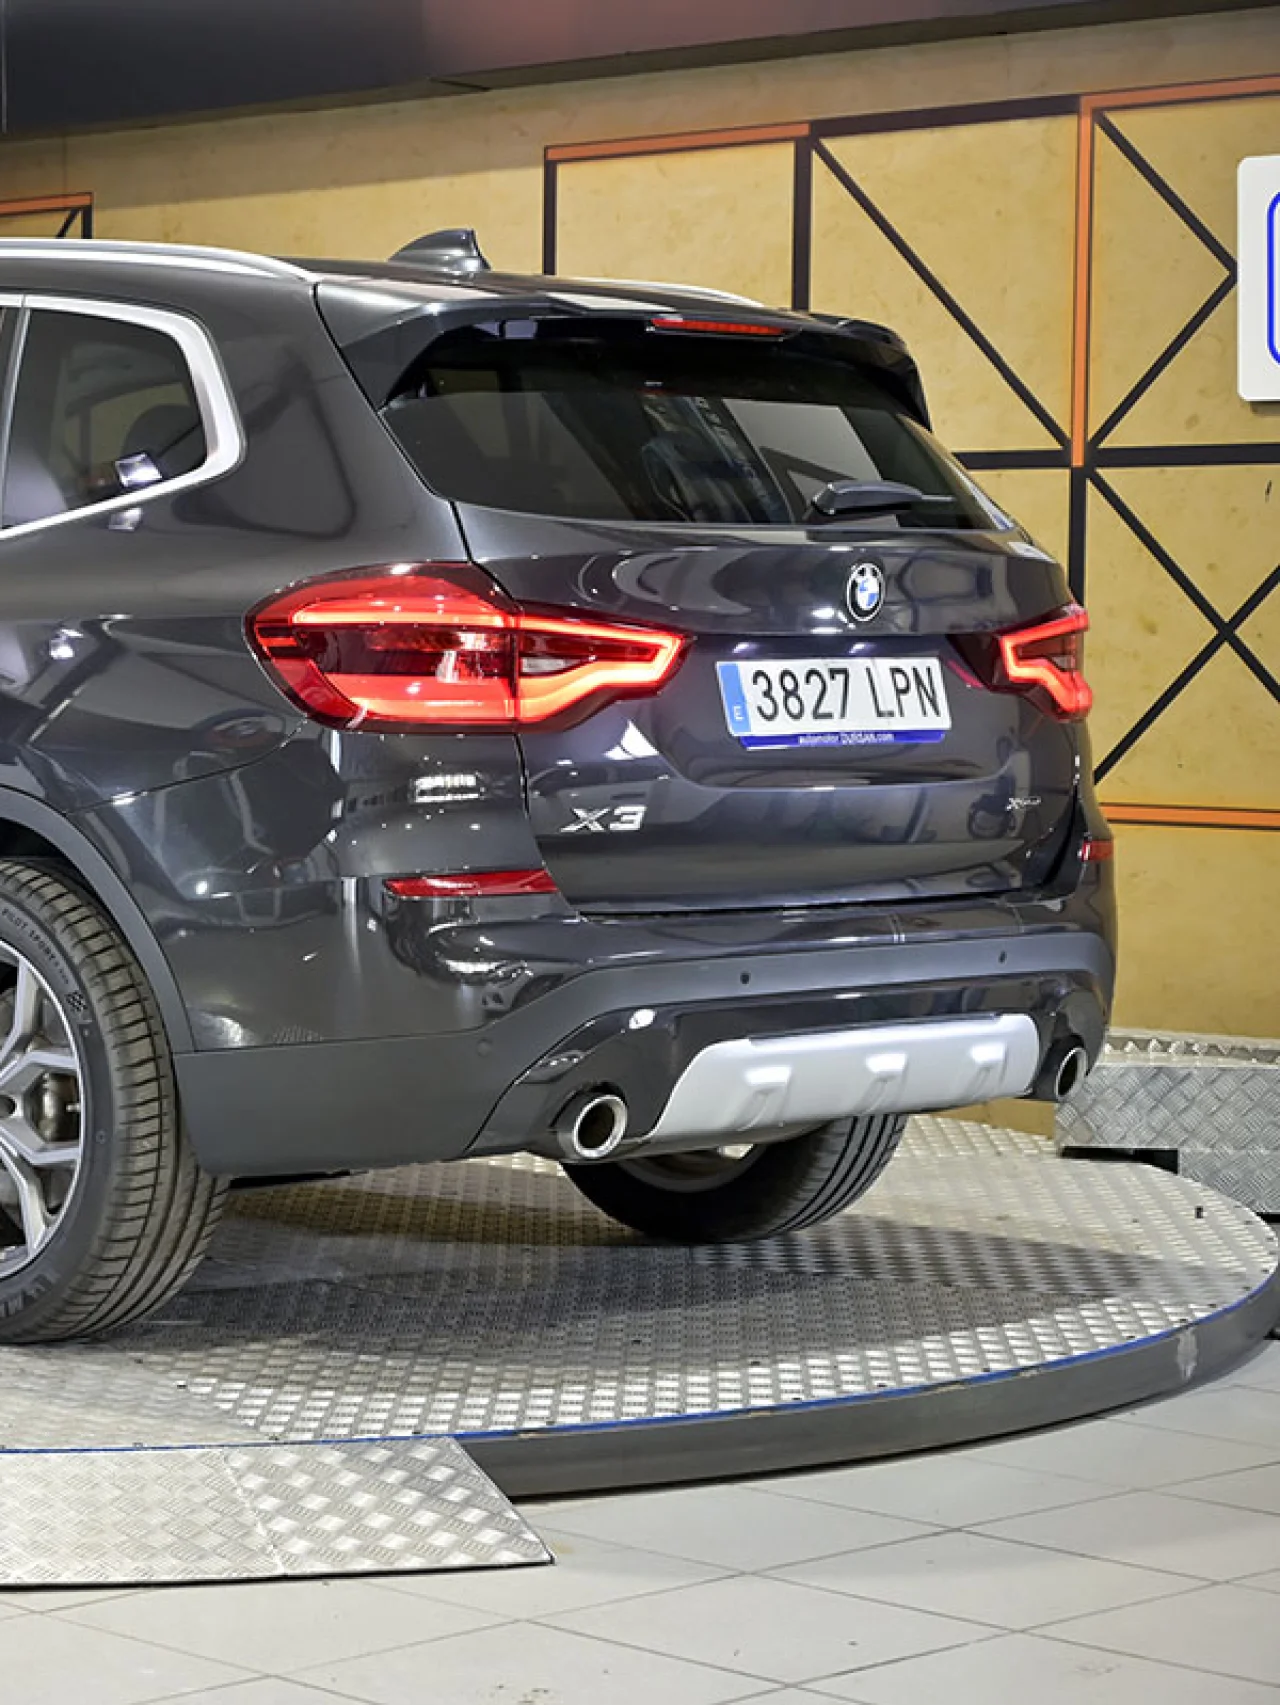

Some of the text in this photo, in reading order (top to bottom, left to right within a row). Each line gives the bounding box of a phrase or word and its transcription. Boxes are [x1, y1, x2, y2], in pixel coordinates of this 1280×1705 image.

[751, 666, 941, 721] 3827 LPN
[733, 705, 745, 720] E
[560, 805, 648, 833] X3
